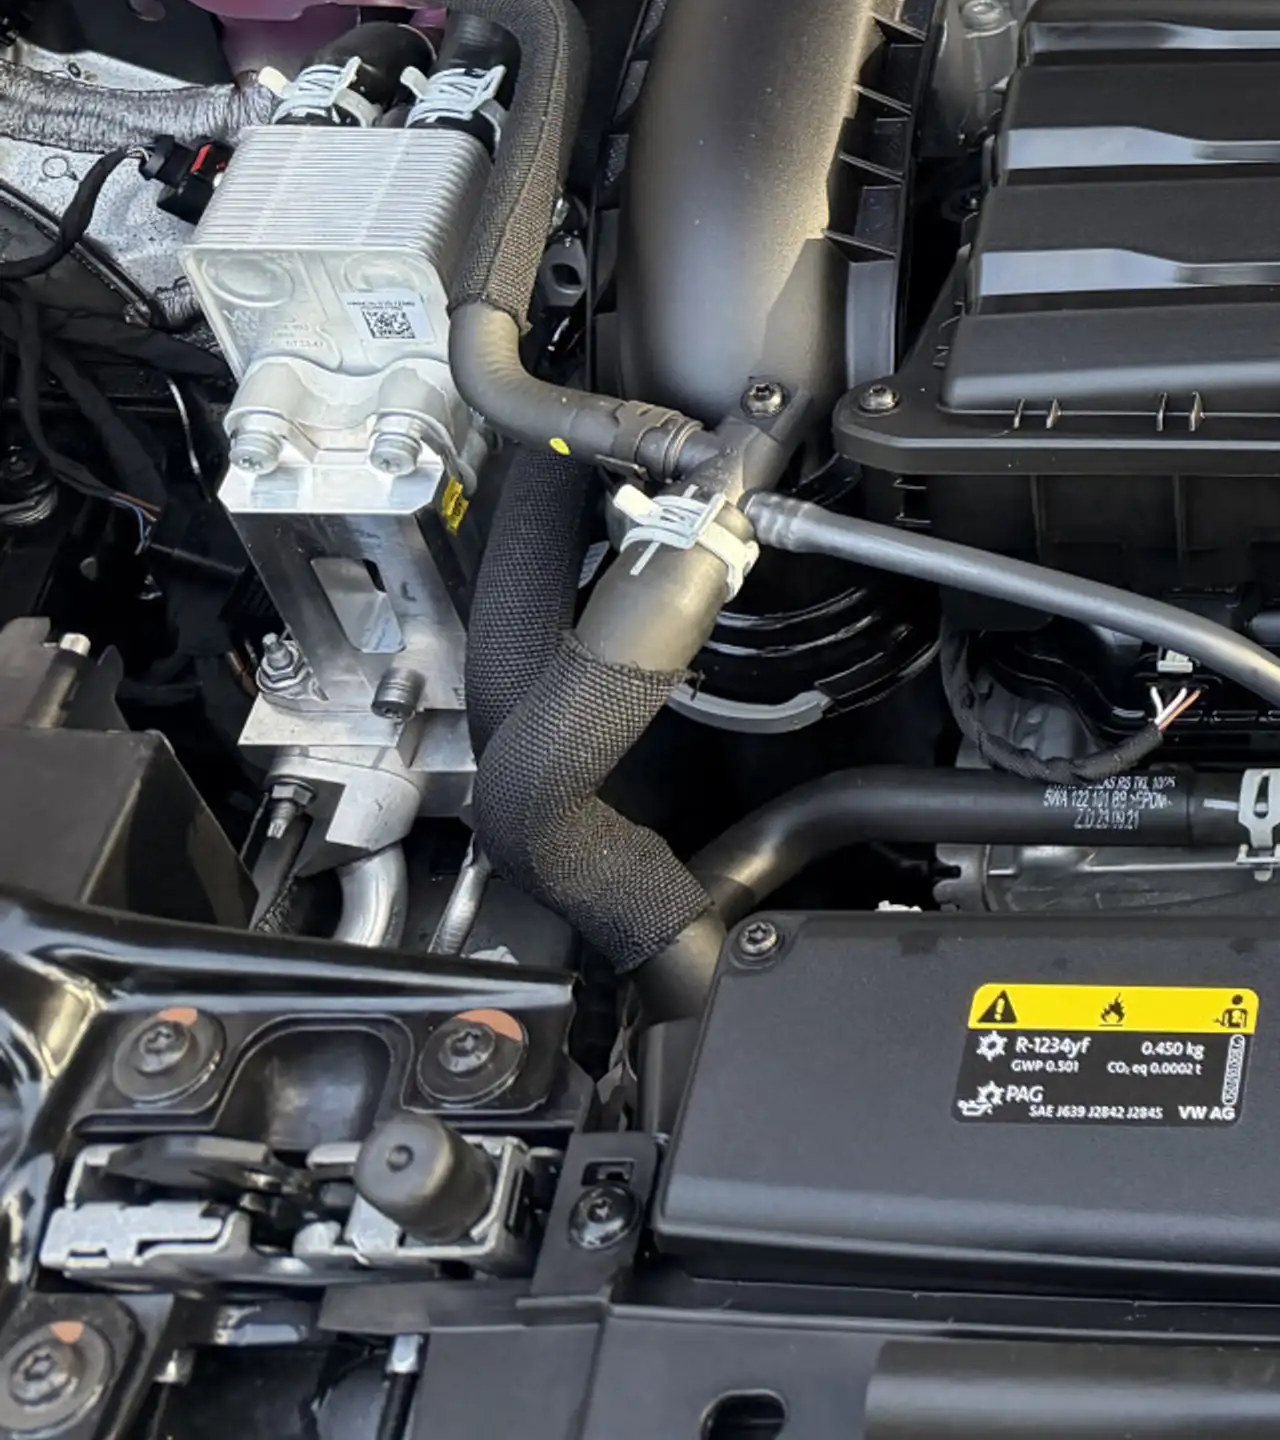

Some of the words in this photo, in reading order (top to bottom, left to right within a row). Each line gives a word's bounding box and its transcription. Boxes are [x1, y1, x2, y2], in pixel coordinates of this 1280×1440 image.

[1015, 1036, 1091, 1058] R-1234yf
[1141, 1041, 1184, 1056] 0.450
[1186, 1041, 1205, 1060] kg
[1010, 1060, 1044, 1072] GWP
[1045, 1060, 1080, 1073] 0.501
[1132, 1064, 1148, 1077] eq
[1150, 1062, 1194, 1075] 0.0002
[1195, 1063, 1203, 1075] t
[1005, 1085, 1045, 1103] PAG
[1028, 1104, 1054, 1117] SAE
[1055, 1105, 1086, 1118] J639
[1087, 1105, 1125, 1119] J2842
[1177, 1105, 1208, 1120] VW
[1208, 1106, 1236, 1121] AG
